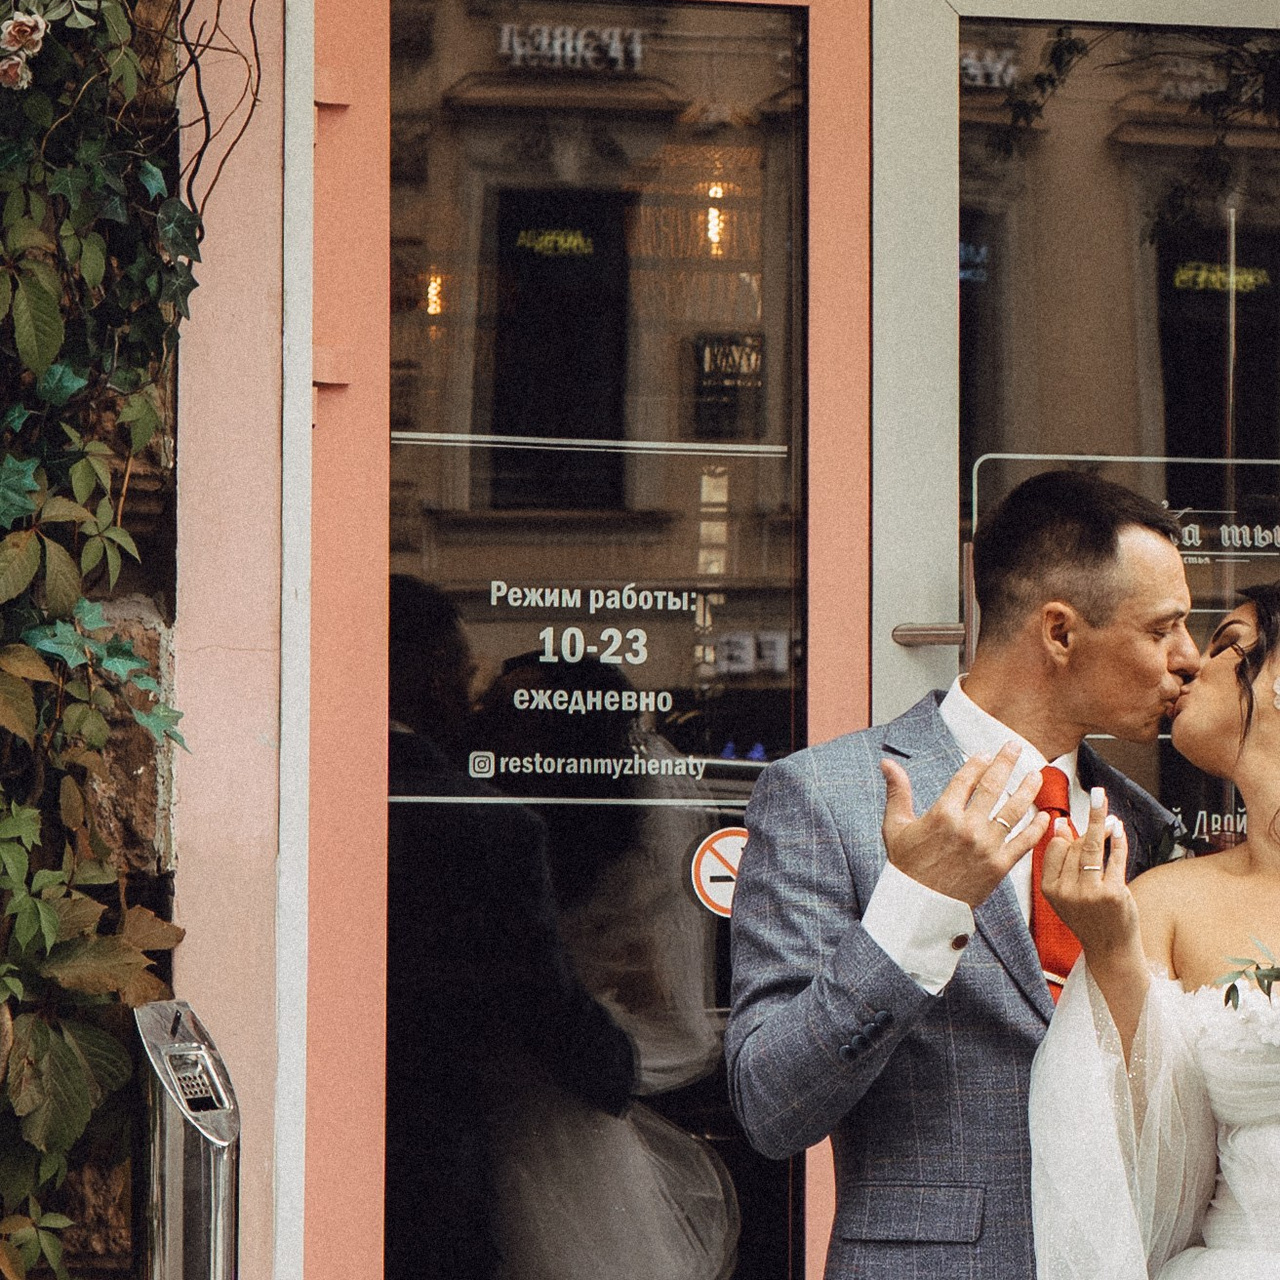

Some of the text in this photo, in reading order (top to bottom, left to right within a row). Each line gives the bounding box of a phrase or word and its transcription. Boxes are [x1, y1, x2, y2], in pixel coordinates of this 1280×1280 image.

[490, 580, 698, 614] Режим работы:
[538, 626, 648, 665] 10-23
[513, 686, 673, 715] ежедневно
[499, 751, 707, 781] restoranmyzhenaty
